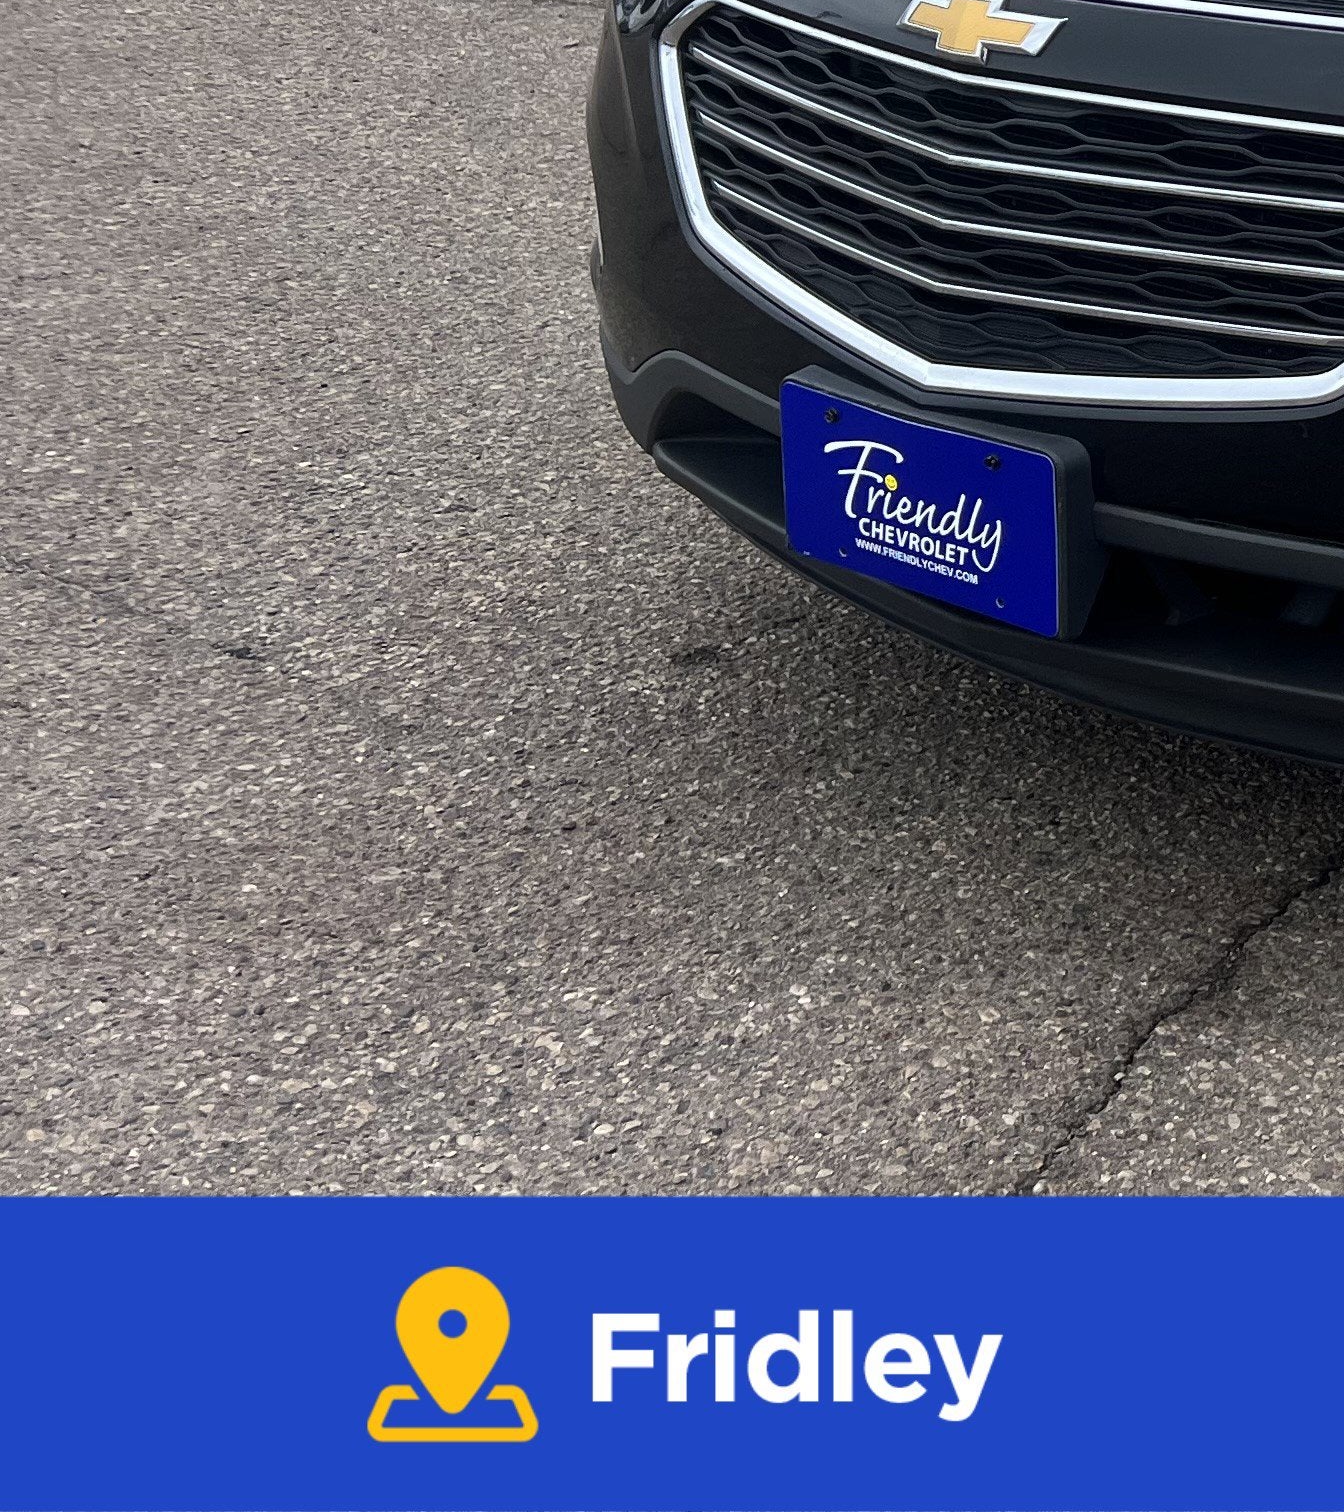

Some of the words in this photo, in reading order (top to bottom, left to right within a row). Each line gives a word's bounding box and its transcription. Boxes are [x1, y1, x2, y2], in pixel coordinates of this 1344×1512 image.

[824, 440, 1002, 573] Friendly
[855, 537, 979, 585] WWW.FRIENDLYCHEV.COM
[858, 517, 970, 566] CHEVROLET
